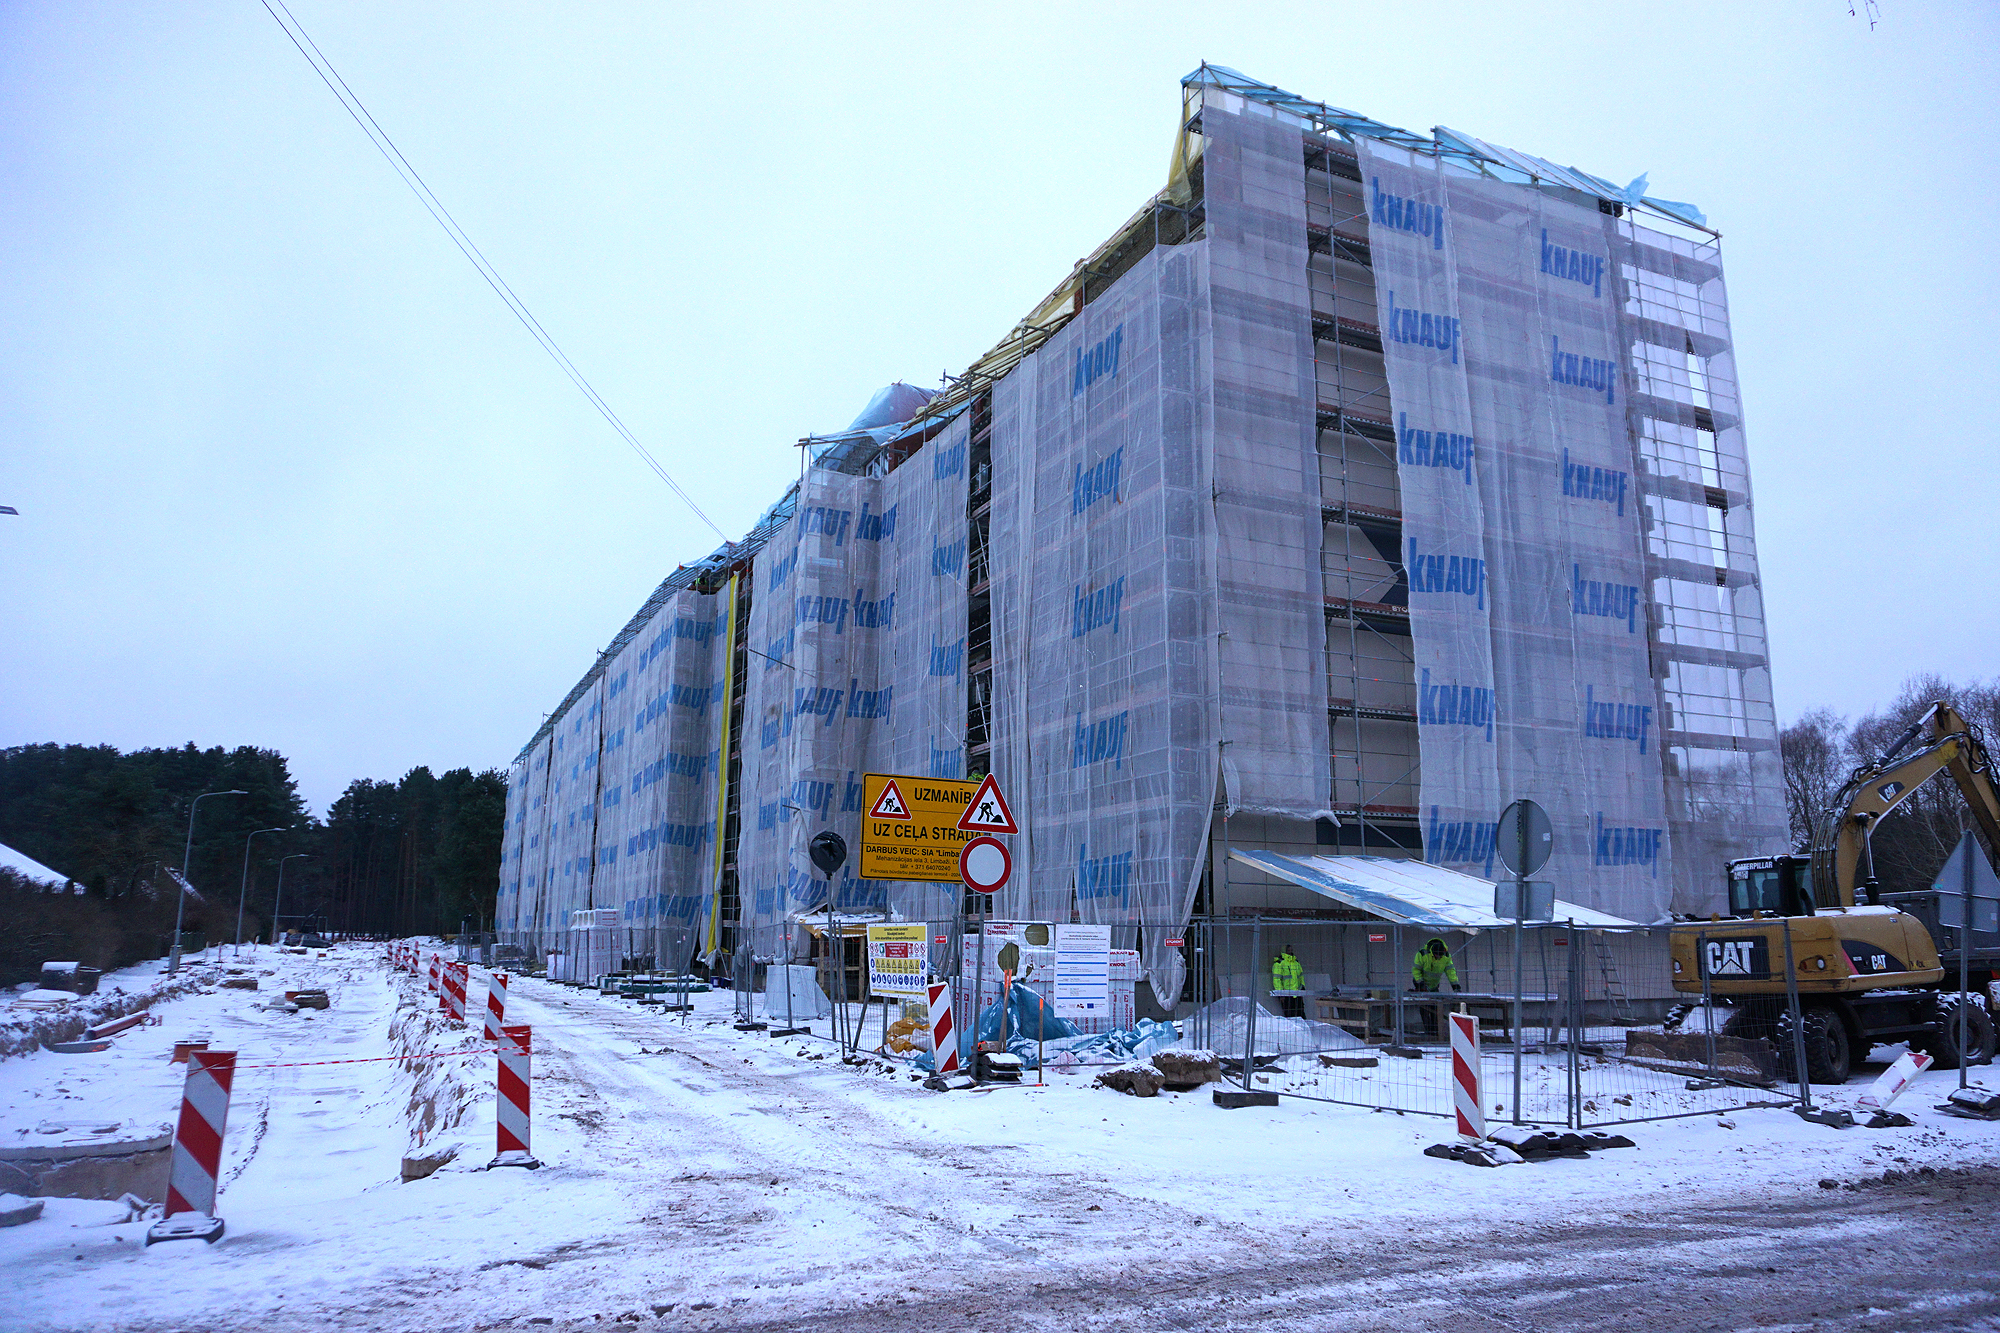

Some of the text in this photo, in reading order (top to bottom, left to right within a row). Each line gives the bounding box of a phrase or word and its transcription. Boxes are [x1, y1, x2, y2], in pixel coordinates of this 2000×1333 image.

[1371, 177, 1443, 250] KNAUF
[1540, 228, 1604, 298] KNAUF
[1388, 290, 1461, 365] KNAUF
[1551, 334, 1616, 405] KNAUF
[1399, 411, 1474, 485] KNAUF
[1562, 447, 1628, 516] KNAUF
[1409, 536, 1485, 611] KNAUF
[1573, 562, 1639, 634] KNAUF
[1418, 667, 1496, 743] KNAUF
[1585, 684, 1653, 755] KNAUF
[914, 787, 976, 804] UZMANĪB
[1884, 783, 1897, 799] CAT
[866, 845, 960, 858] DARBUS VEIC: SIA "Limba
[873, 822, 891, 837] UZ
[894, 824, 928, 842] CEĻA
[1427, 804, 1498, 878] KNAUF
[1595, 810, 1662, 879] KNAUF
[1736, 861, 1773, 870] CATERPILLAR
[1707, 941, 1754, 975] CAT
[1871, 954, 1886, 970] CAT
